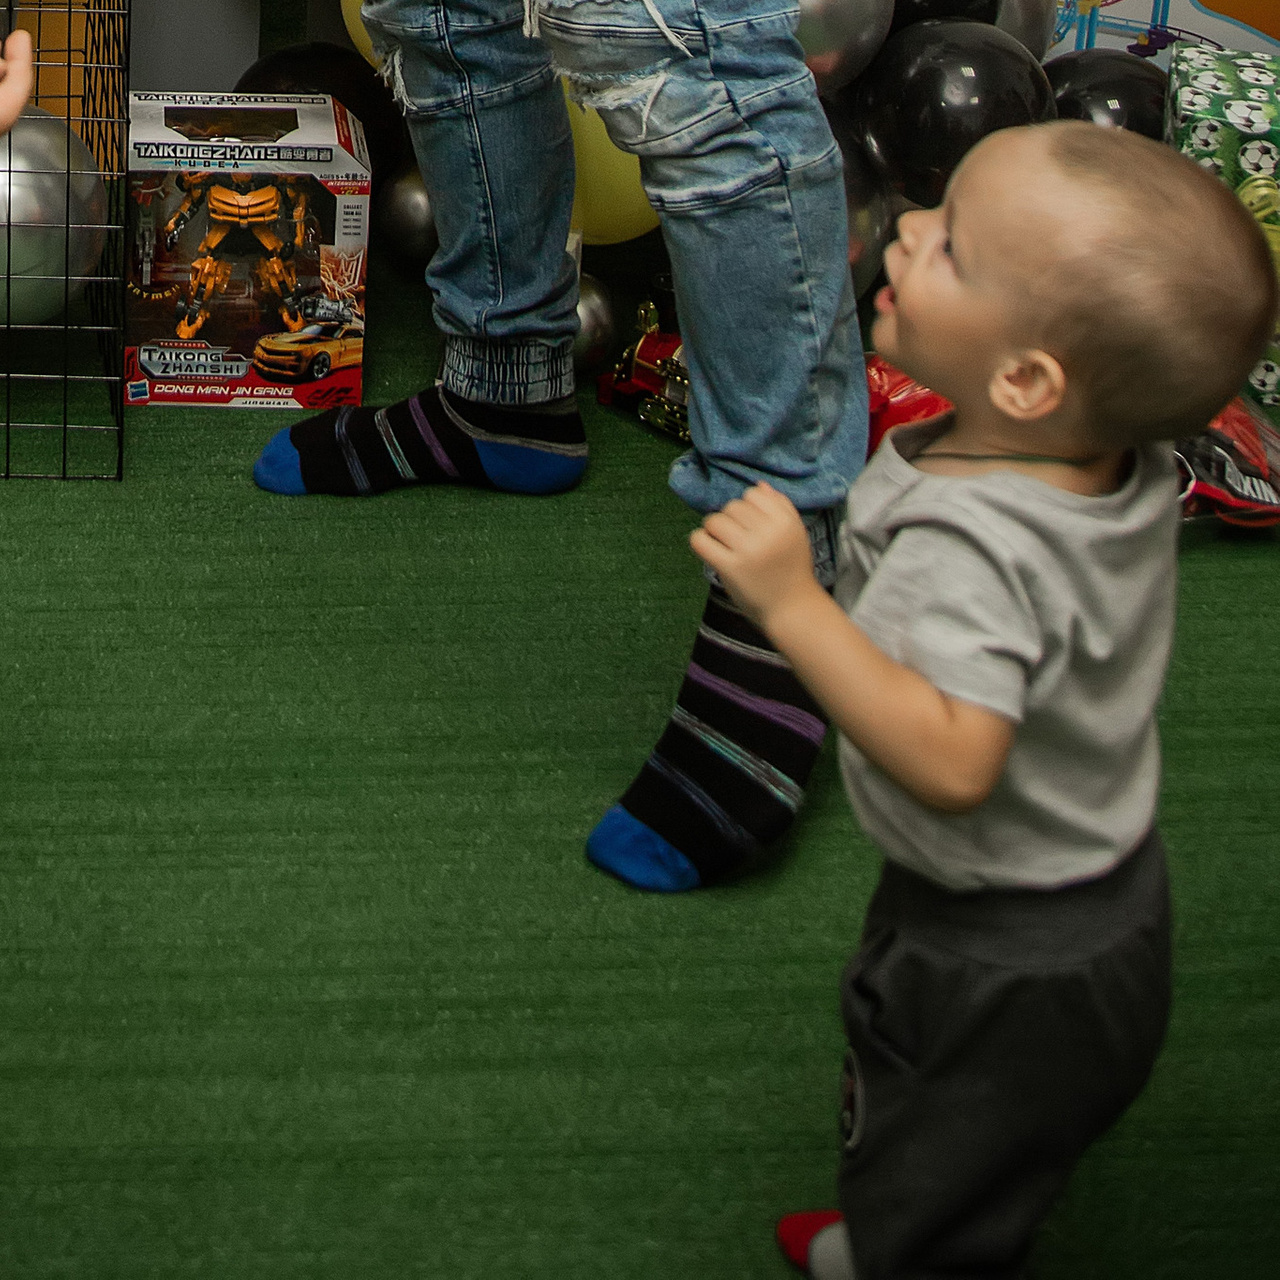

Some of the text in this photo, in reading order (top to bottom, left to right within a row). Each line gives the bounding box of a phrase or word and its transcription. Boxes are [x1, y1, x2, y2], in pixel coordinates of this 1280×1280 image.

[135, 143, 278, 161] TAIKONGZHANS
[142, 347, 221, 362] TAIKONG
[160, 362, 241, 375] ZHANSHI
[154, 384, 295, 396] DONG MAN JIN GANG
